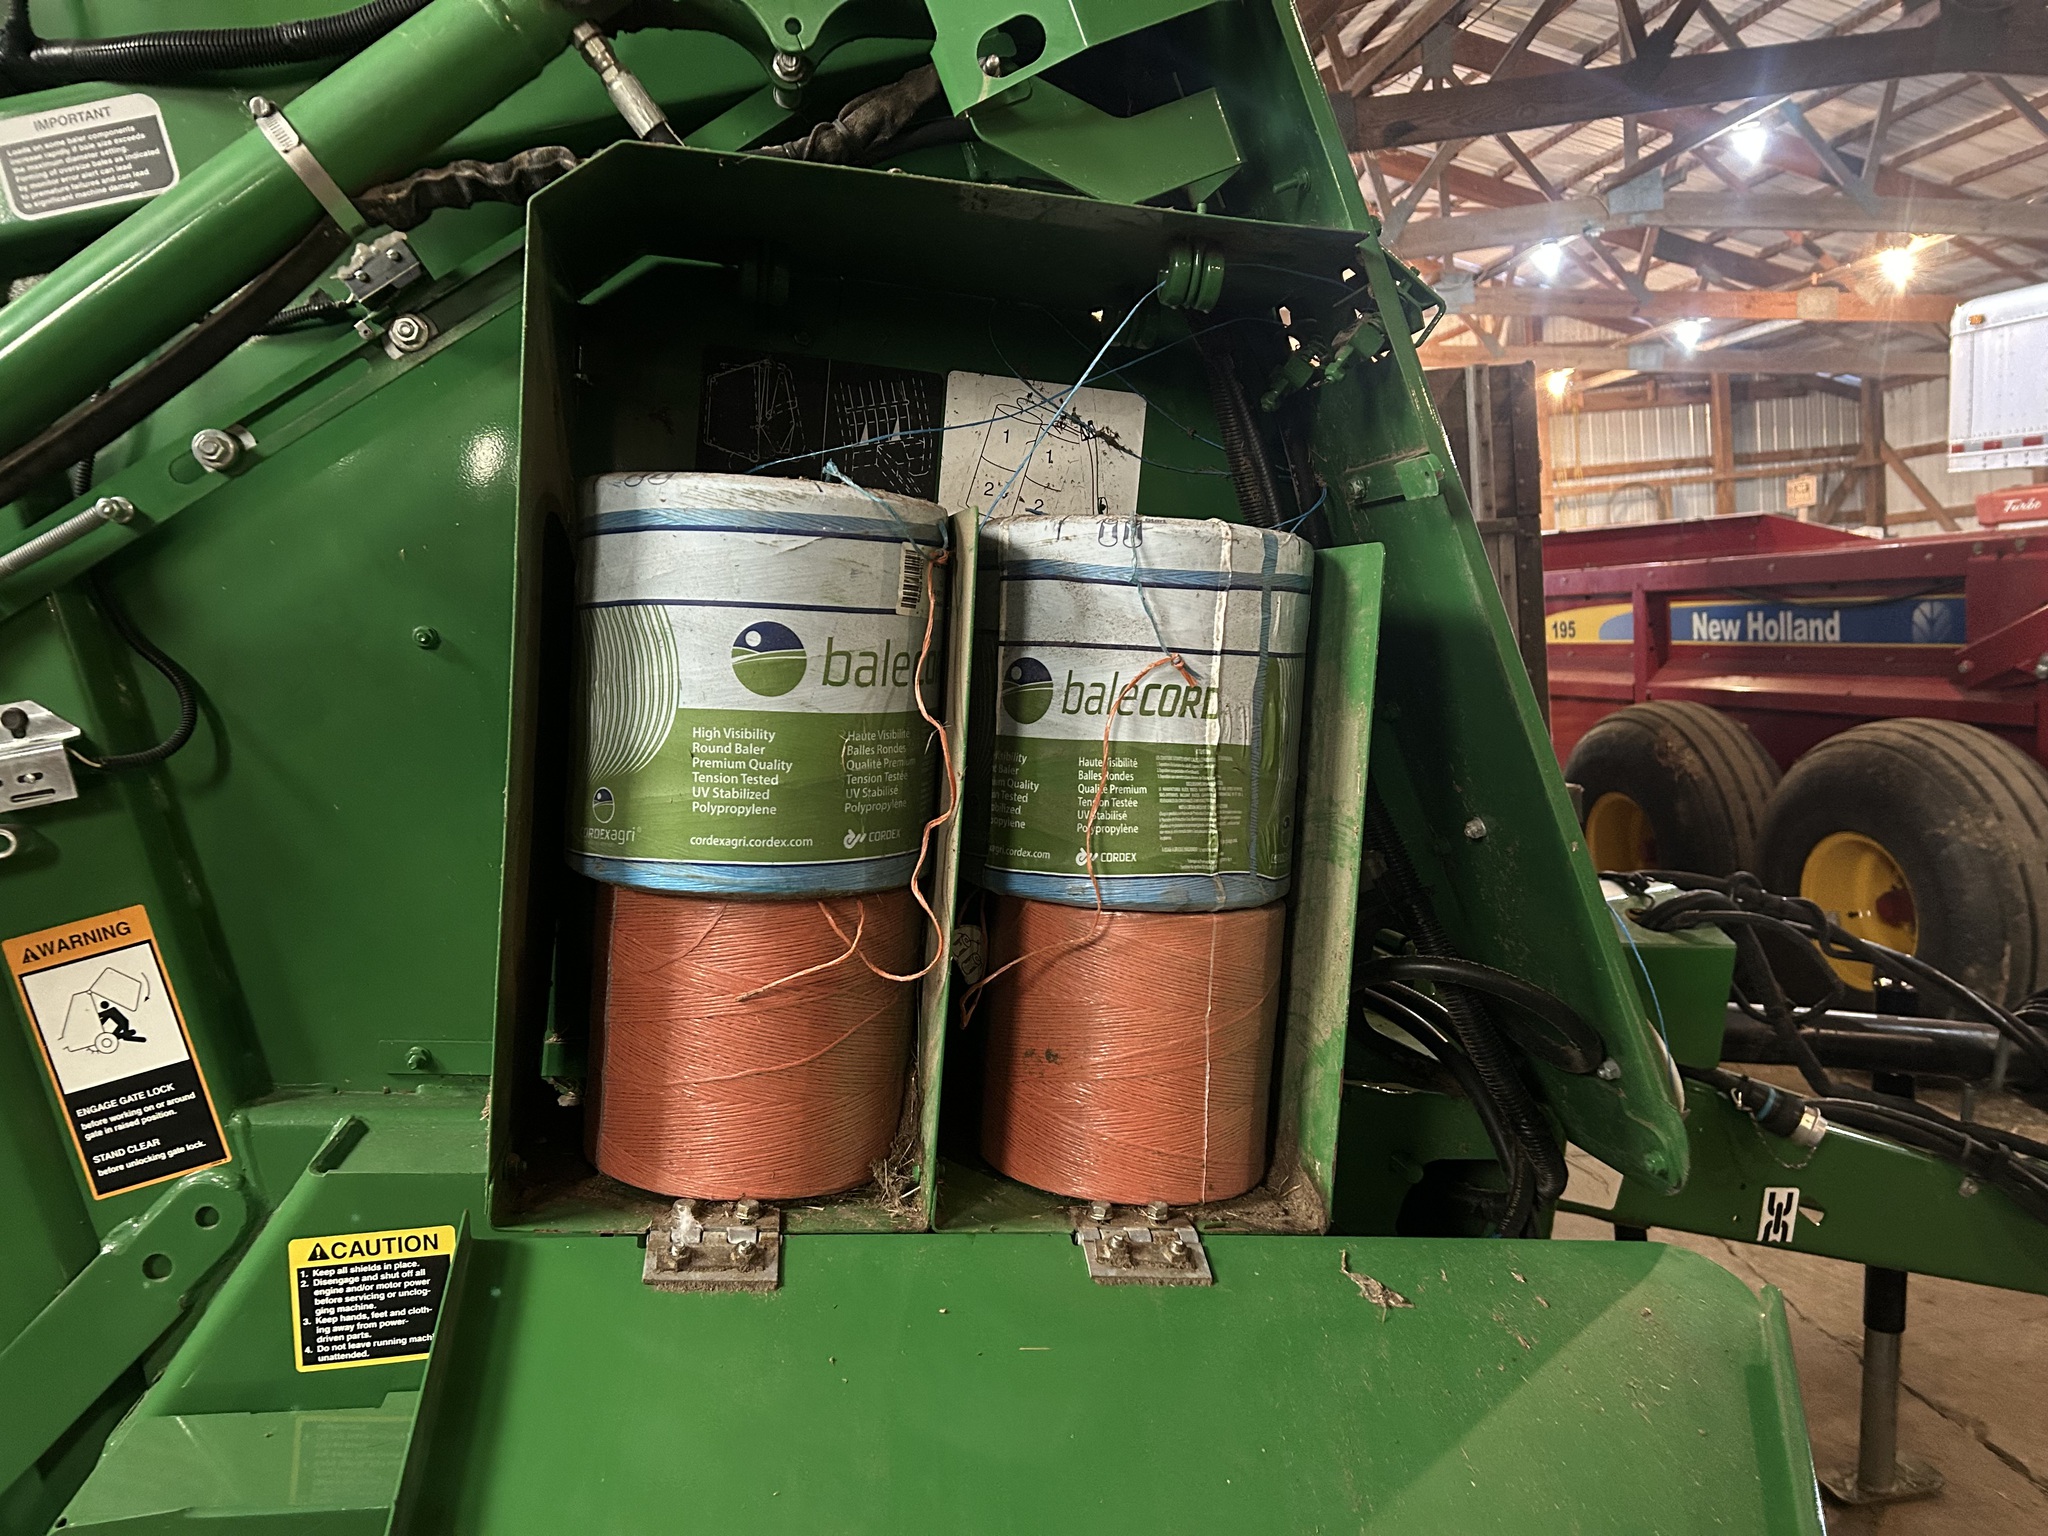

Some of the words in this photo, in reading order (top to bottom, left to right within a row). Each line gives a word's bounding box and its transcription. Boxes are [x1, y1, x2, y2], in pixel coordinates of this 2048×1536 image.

[33, 106, 112, 132] IMPORTANT
[87, 125, 136, 141] components
[97, 139, 112, 147] size
[113, 132, 146, 145] exceeds
[65, 152, 99, 164] diameter
[100, 145, 129, 157] setting.
[91, 157, 113, 167] bales
[125, 147, 161, 161] indicated
[81, 169, 99, 179] alert
[100, 167, 115, 175] can
[115, 163, 133, 172] lead
[101, 174, 117, 184] and
[117, 172, 132, 181] can
[74, 185, 108, 199] machine
[108, 179, 142, 193] damage.
[1003, 429, 1010, 444] 1
[1046, 449, 1053, 464] 1
[983, 481, 995, 496] 2
[1034, 498, 1045, 511] 2
[1552, 620, 1577, 639] 195
[1692, 610, 1741, 642] New
[1746, 608, 1841, 642] Holland
[692, 726, 721, 741] High
[723, 727, 776, 743] Visibility
[847, 730, 876, 741] Haute
[692, 742, 732, 754] Round
[734, 743, 766, 755] Baler
[846, 744, 875, 756] Balles
[877, 742, 907, 754] Rondes
[692, 757, 746, 769] Premium
[748, 758, 793, 774] Quality
[846, 758, 882, 771] Qualité
[1078, 756, 1103, 767] Haute
[692, 771, 739, 784] Tension
[740, 773, 779, 785] Tested
[846, 773, 883, 785] Tension
[884, 771, 909, 782] Testée
[1078, 769, 1103, 781] Balles
[692, 786, 711, 798] UV
[712, 787, 770, 800] Stabilized
[845, 788, 861, 799] UV
[862, 785, 899, 798] Stabilisé
[1007, 778, 1040, 793] Quality
[1077, 783, 1108, 795] Qualié
[1109, 784, 1148, 794] Premium
[1001, 790, 1029, 803] Tested
[1077, 796, 1110, 807] Tenon
[1111, 797, 1139, 808] Testée
[692, 801, 777, 817] Polypropylene
[844, 798, 907, 815] Polypropylène
[1077, 809, 1091, 820] UV
[868, 829, 901, 842] CORDEX
[1076, 822, 1139, 836] Poypropylène
[690, 834, 814, 850] cordexagri.cordex.com
[1100, 852, 1137, 863] CORDEX
[36, 921, 131, 957] WARNING
[76, 1099, 118, 1117] ENGAGE
[118, 1091, 147, 1105] GATE
[146, 1082, 176, 1098] LOCK
[80, 1118, 109, 1130] before
[109, 1108, 143, 1123] working
[143, 1104, 156, 1113] on
[166, 1092, 196, 1106] around
[84, 1128, 104, 1142] gate
[104, 1124, 113, 1134] in
[114, 1116, 141, 1131] raised
[141, 1109, 178, 1125] position.
[92, 1147, 126, 1164] STAND
[126, 1138, 161, 1154] CLEAR
[97, 1163, 125, 1177] before
[125, 1151, 167, 1168] unlocking
[167, 1145, 187, 1159] gate
[186, 1140, 207, 1152] lock.
[331, 1233, 439, 1259] CAUTION
[300, 1270, 309, 1278] 1.
[312, 1268, 335, 1279] Keep
[337, 1266, 348, 1275] all
[350, 1262, 382, 1273] shields
[383, 1262, 393, 1270] in
[393, 1260, 420, 1271] place.
[300, 1280, 309, 1288] 2.
[313, 1274, 360, 1287] Disengage
[361, 1273, 379, 1282] and
[380, 1270, 400, 1280] shut
[401, 1269, 414, 1278] off
[415, 1269, 426, 1277] all
[313, 1286, 344, 1297] engine
[345, 1282, 374, 1292] and/or
[375, 1281, 402, 1291] motor
[403, 1278, 431, 1288] power
[314, 1296, 343, 1306] before
[344, 1291, 386, 1304] servicing
[398, 1287, 432, 1299] unclog-
[302, 1318, 312, 1326] 3.
[315, 1315, 338, 1325] Keep
[339, 1312, 370, 1323] hands,
[370, 1310, 388, 1319] feet
[389, 1308, 407, 1317] and
[407, 1306, 433, 1316] cloth-
[315, 1306, 336, 1317] ging
[336, 1302, 377, 1313] machine.
[316, 1326, 331, 1336] ing
[332, 1322, 355, 1333] away
[356, 1321, 377, 1330] from
[379, 1319, 409, 1329] power-
[304, 1346, 313, 1354] 4.
[317, 1344, 330, 1353] Do
[331, 1342, 347, 1351] not
[348, 1339, 372, 1350] leave
[372, 1336, 408, 1348] running
[316, 1334, 344, 1344] driven
[346, 1331, 372, 1343] parts.
[317, 1350, 370, 1362] unattended.
